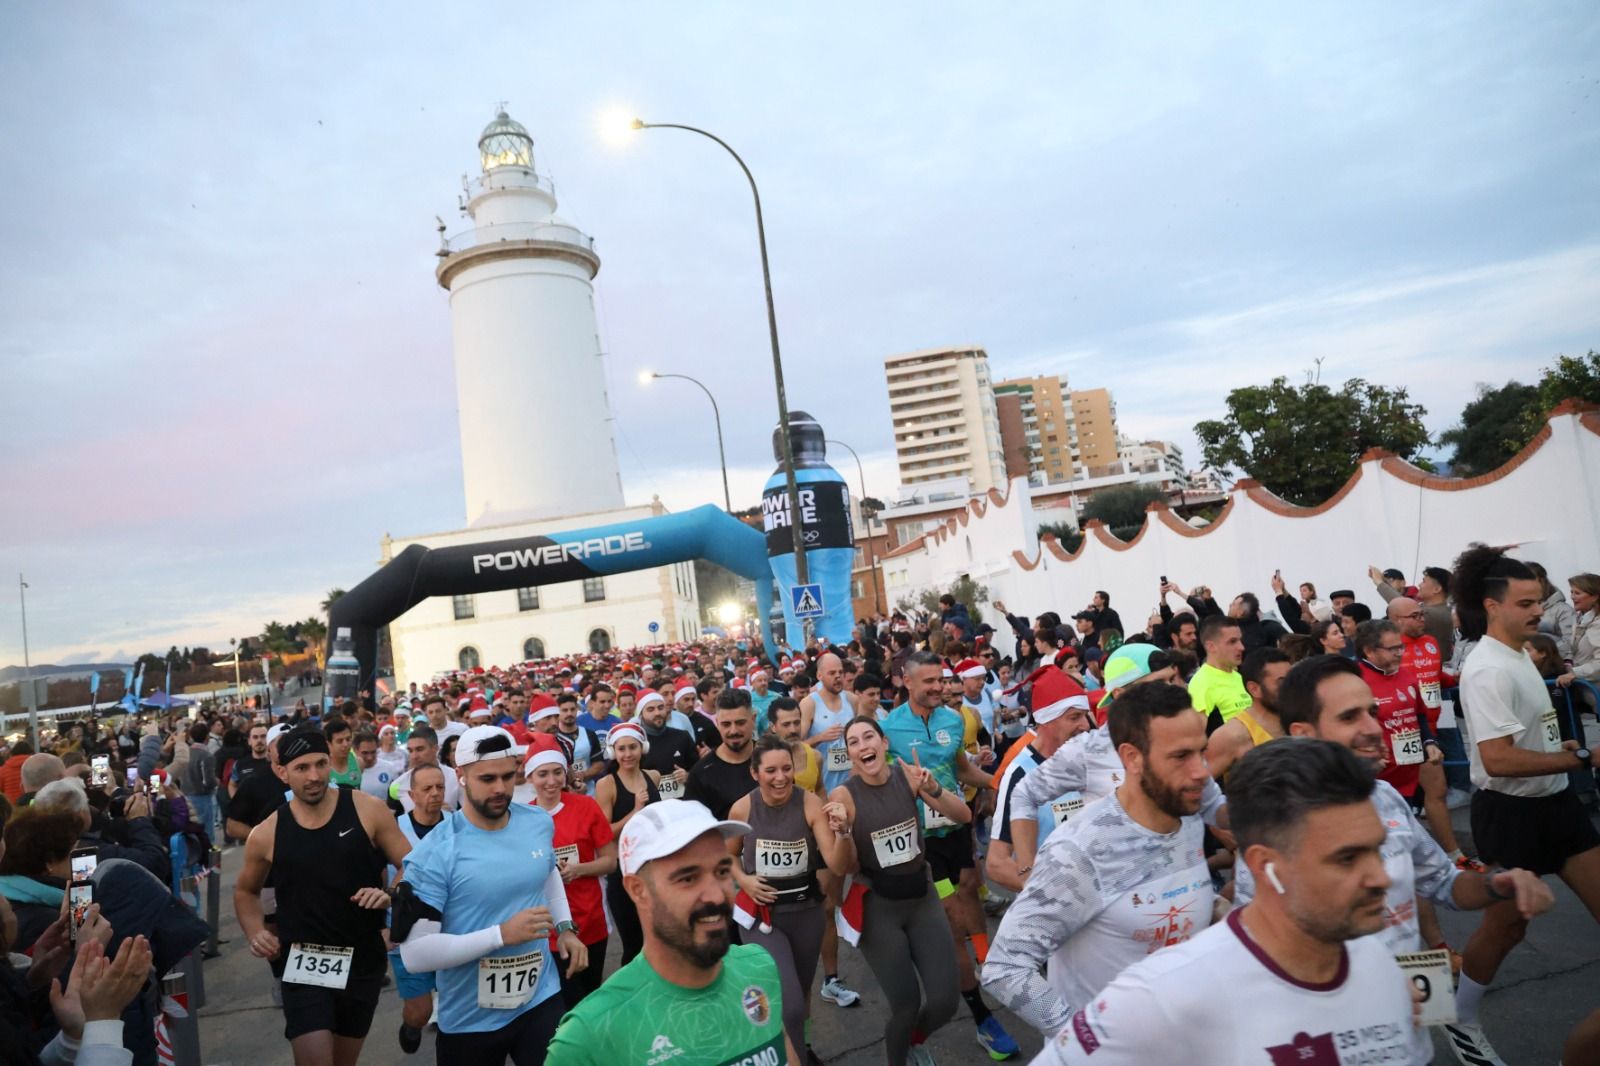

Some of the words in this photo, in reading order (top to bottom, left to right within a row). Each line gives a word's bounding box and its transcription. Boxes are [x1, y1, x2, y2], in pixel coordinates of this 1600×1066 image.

[473, 531, 646, 574] POWERADE
[833, 753, 849, 765] 50
[659, 780, 679, 793] 480
[885, 832, 912, 853] 107
[761, 851, 803, 866] 1037
[294, 953, 342, 976] 1354
[500, 957, 516, 965] SAN
[486, 967, 538, 993] 1176
